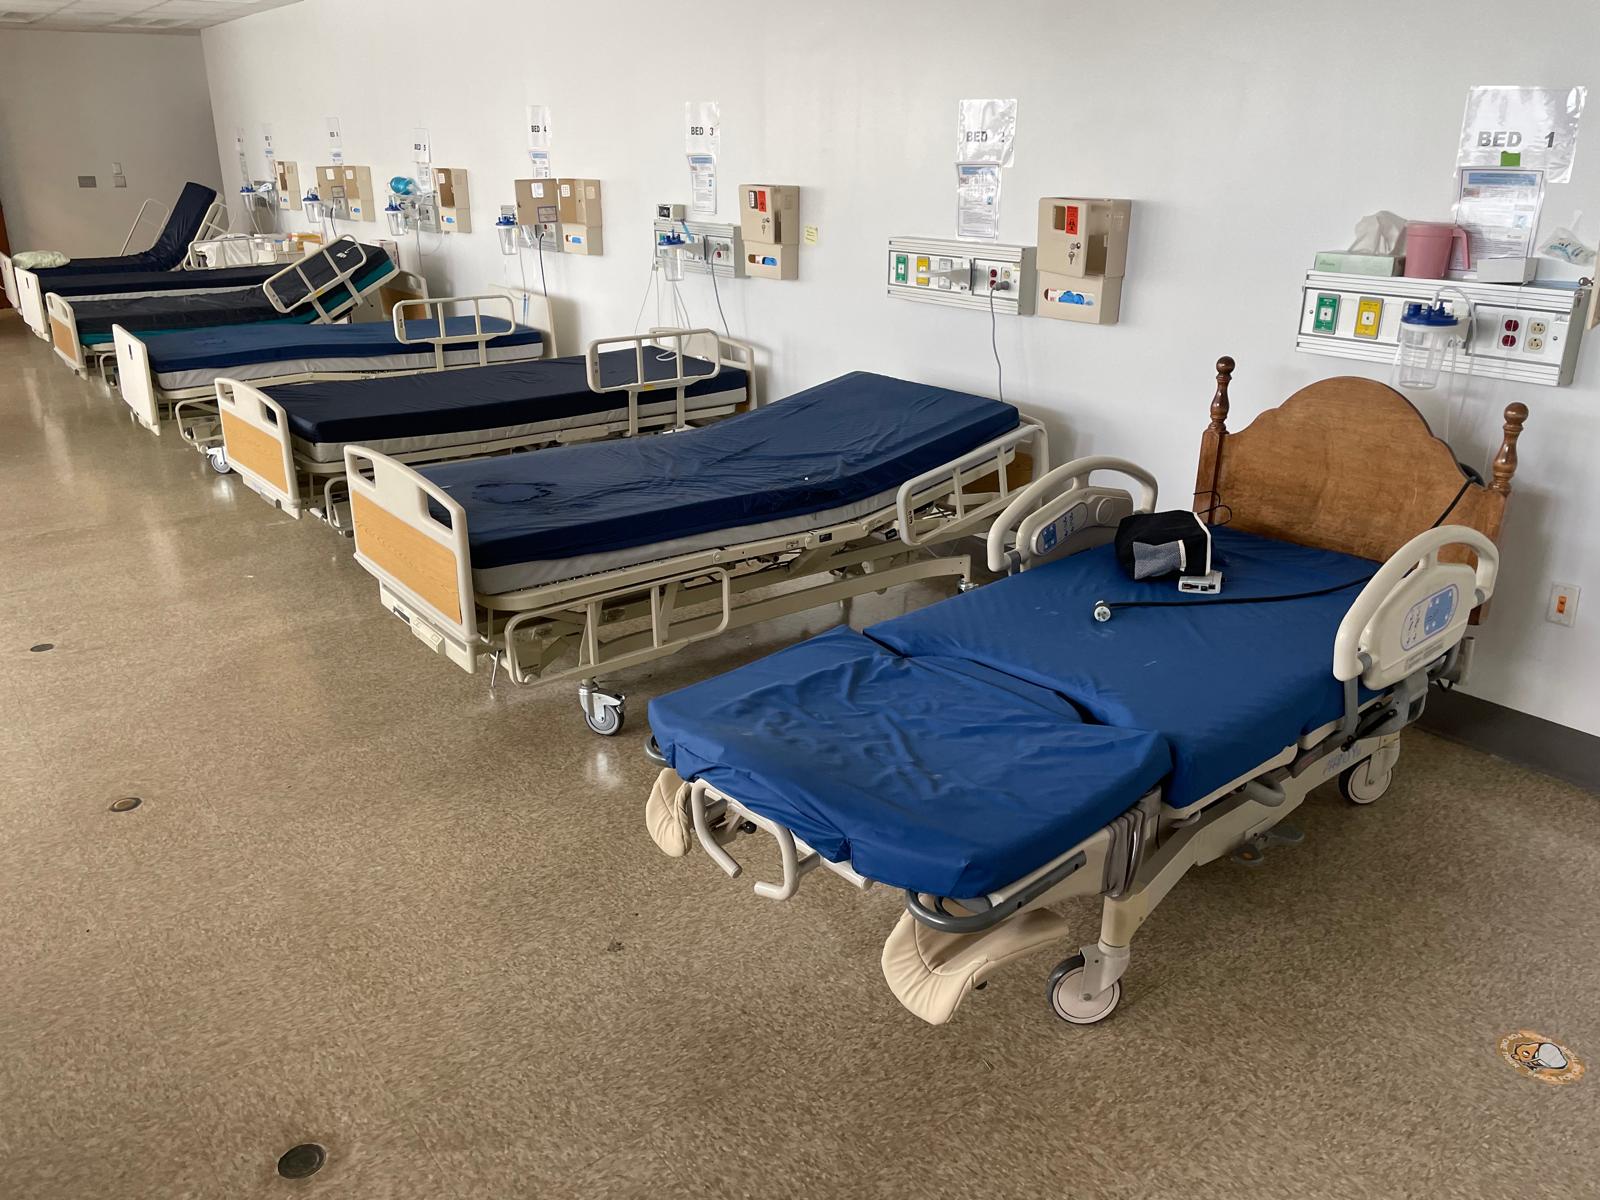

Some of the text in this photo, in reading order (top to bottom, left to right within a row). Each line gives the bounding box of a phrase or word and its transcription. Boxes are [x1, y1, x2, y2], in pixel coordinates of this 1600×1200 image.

[691, 126, 714, 137] BED 3
[966, 131, 988, 143] BED
[1478, 131, 1555, 148] BED 1
